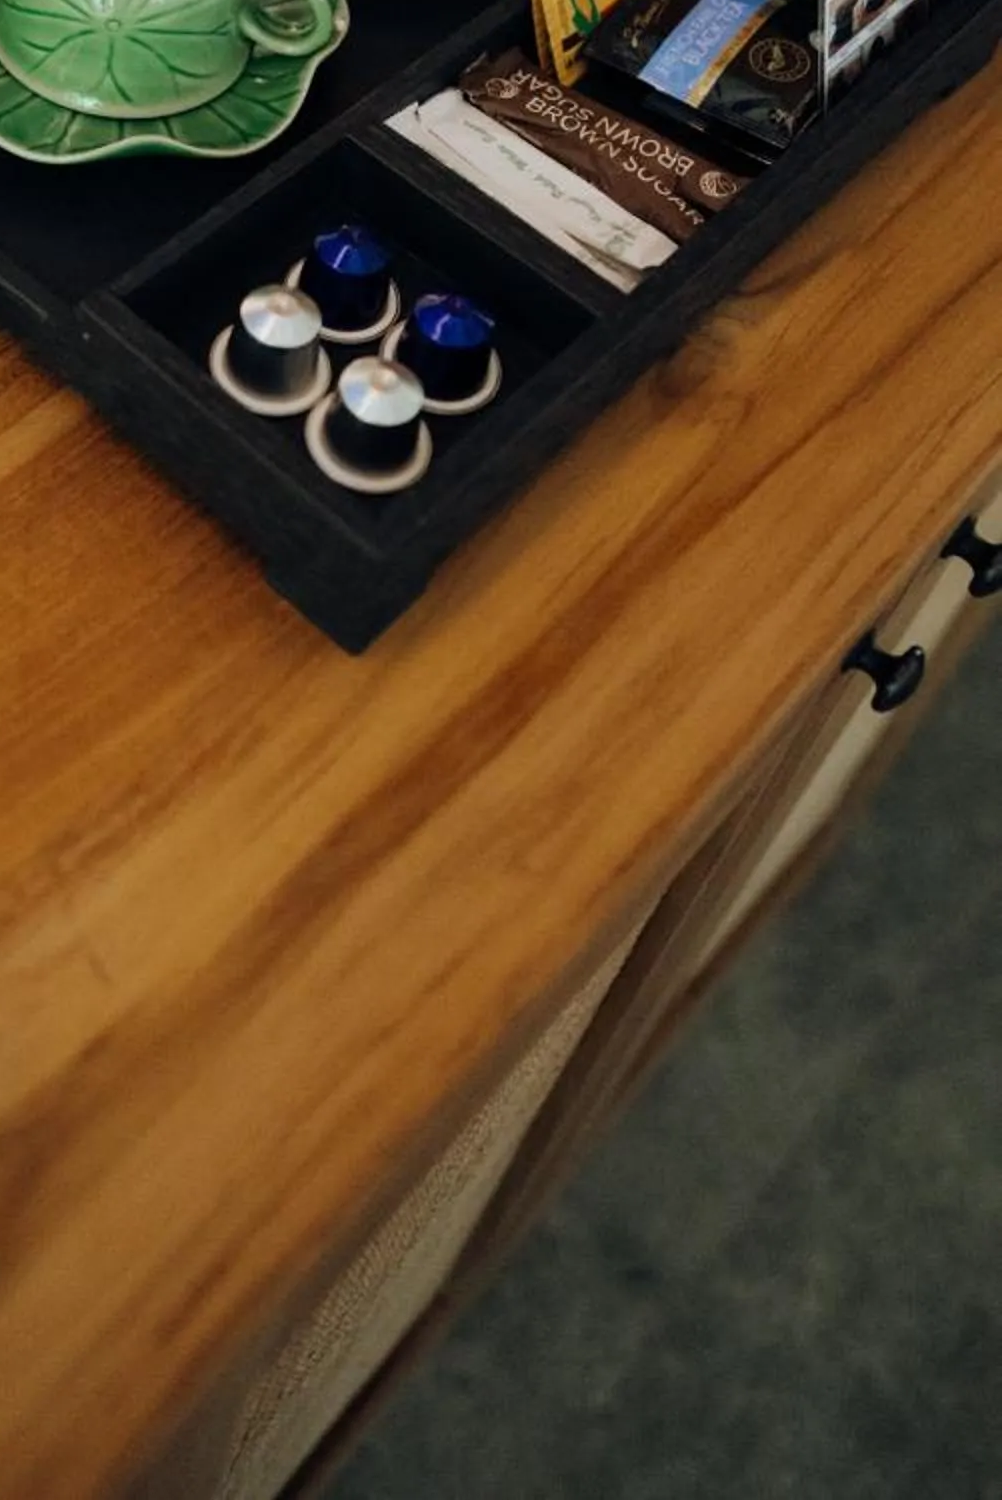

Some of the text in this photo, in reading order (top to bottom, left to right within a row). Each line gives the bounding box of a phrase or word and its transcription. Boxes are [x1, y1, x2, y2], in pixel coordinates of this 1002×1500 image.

[511, 69, 595, 122] SUGAR
[525, 97, 622, 159] BROWN
[595, 116, 696, 178] BROWN
